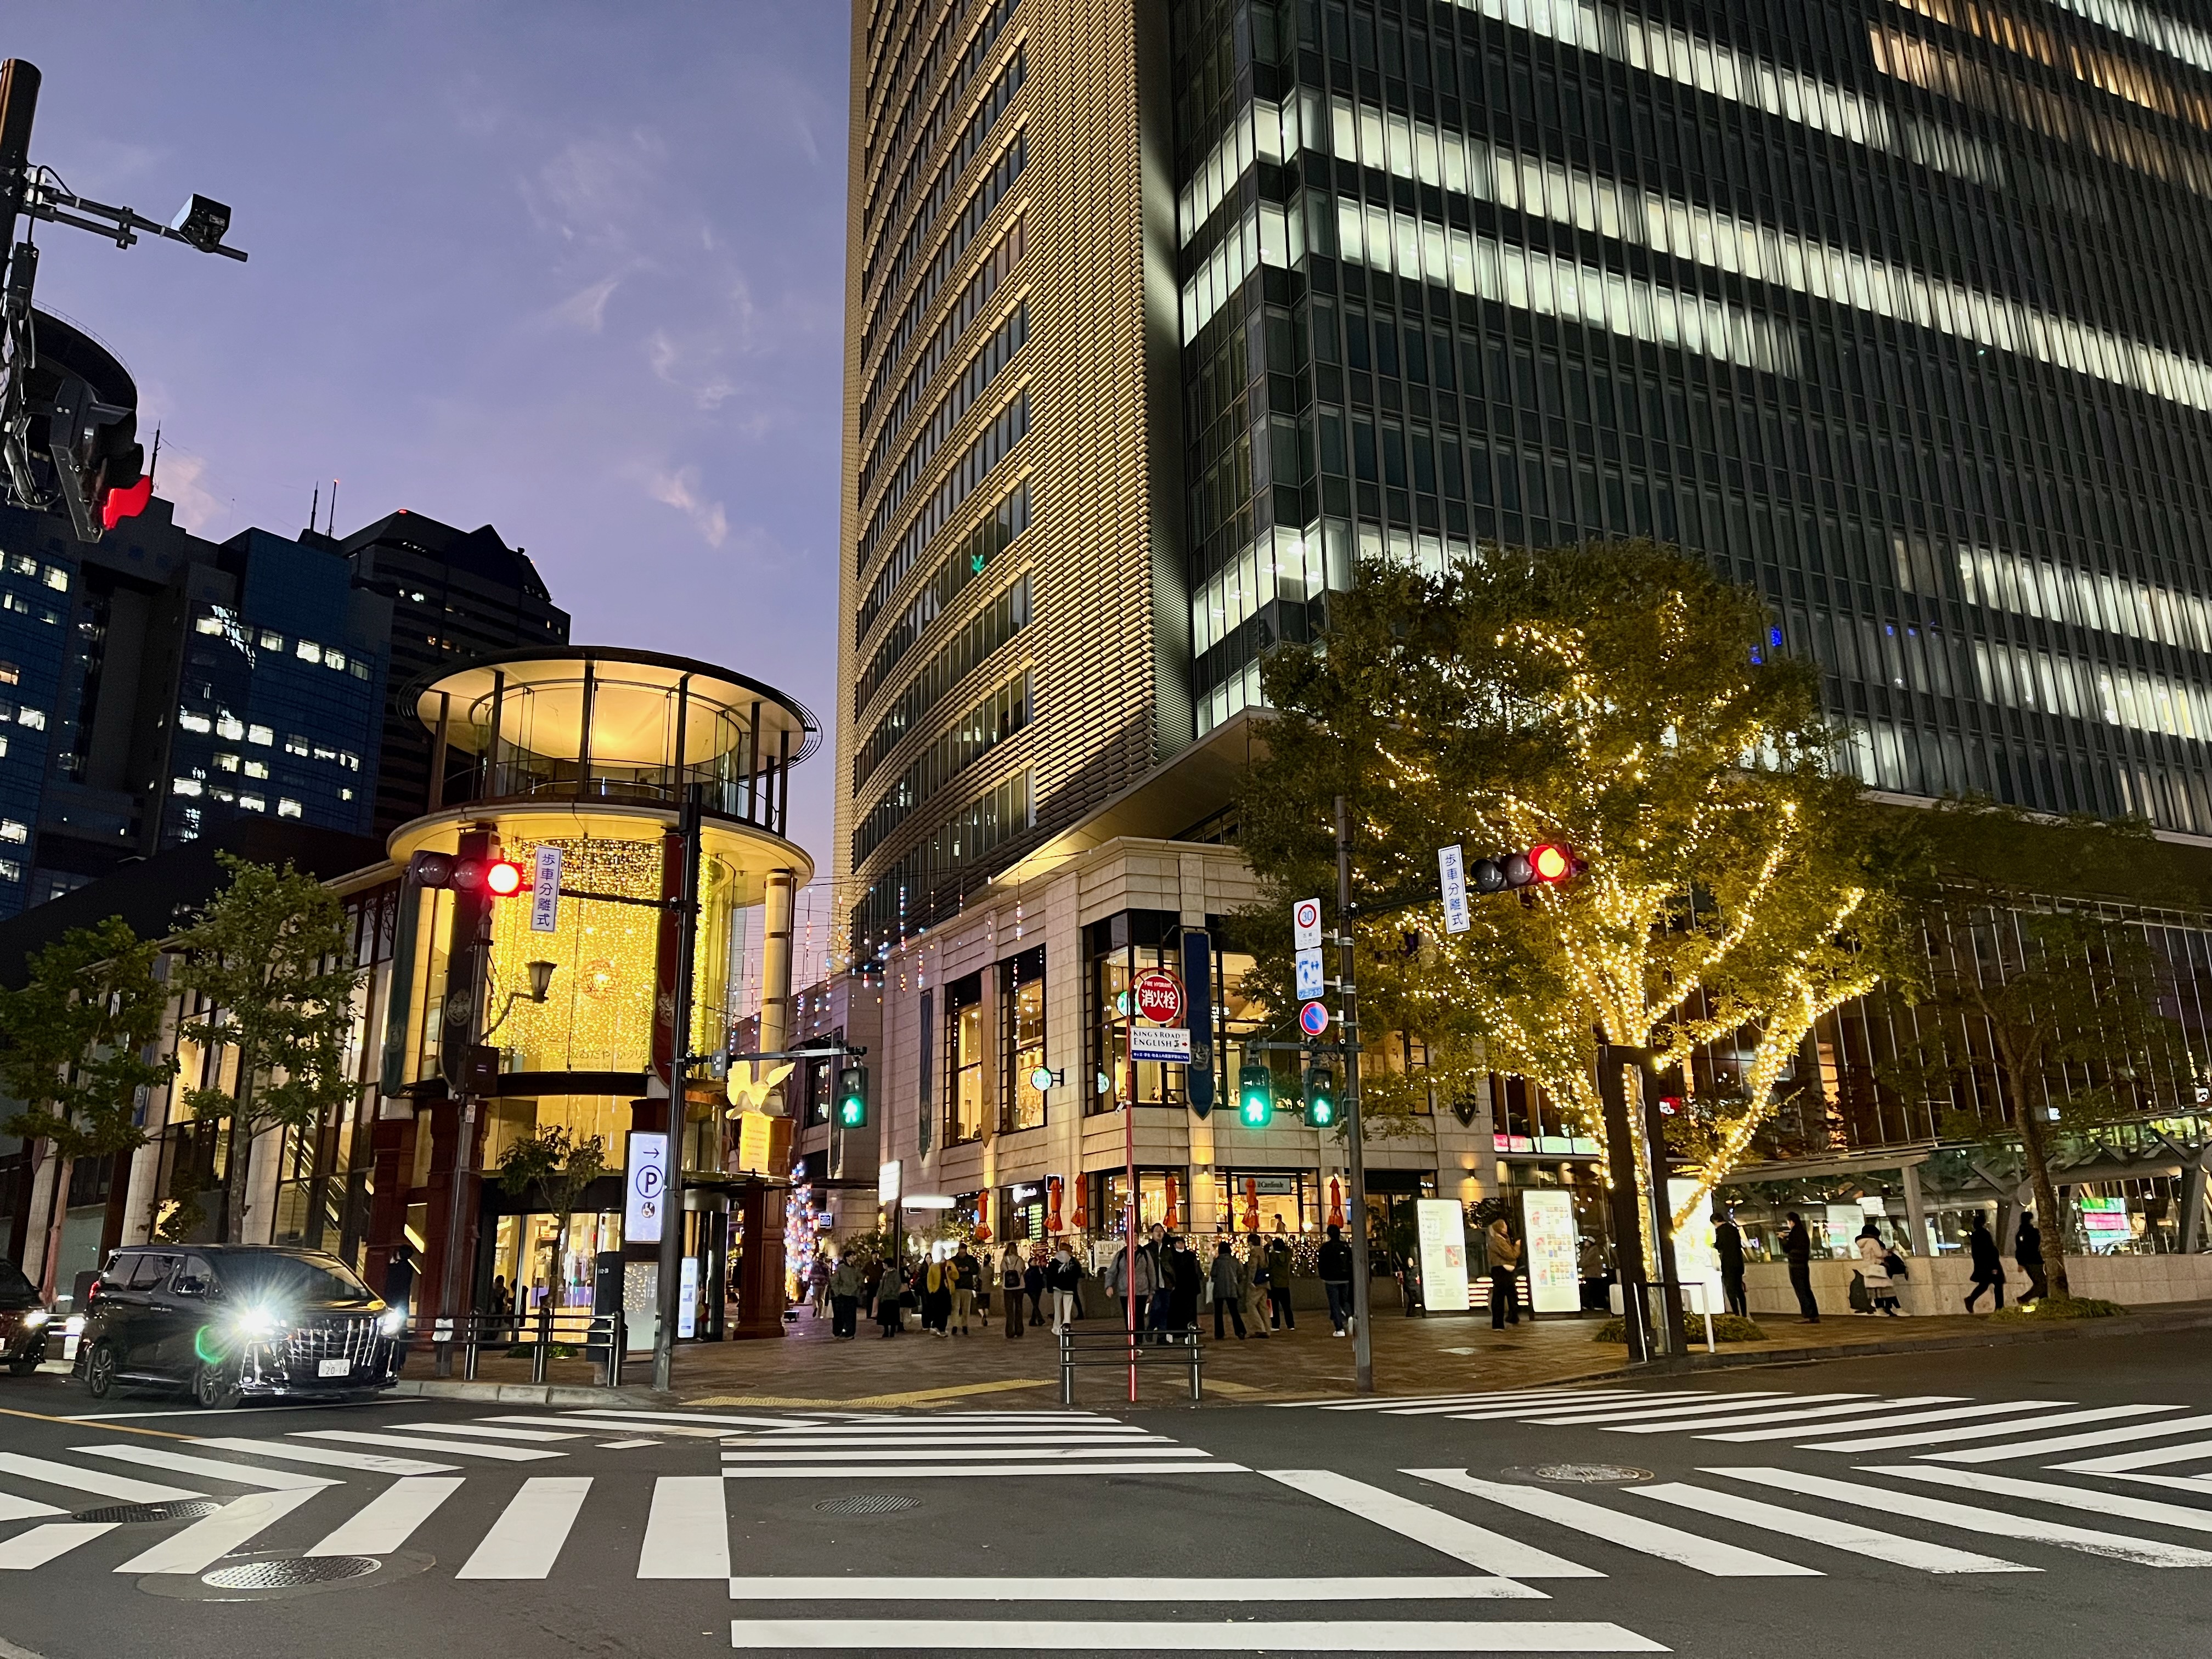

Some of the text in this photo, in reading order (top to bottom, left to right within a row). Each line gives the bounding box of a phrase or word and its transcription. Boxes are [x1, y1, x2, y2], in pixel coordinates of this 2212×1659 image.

[537, 853, 555, 927] 歩車分離式
[1445, 854, 1463, 926] 歩車分離式
[1302, 910, 1312, 922] 30
[1141, 989, 1176, 1009] 消火栓
[1133, 1037, 1172, 1047] ENGLISH
[645, 1172, 657, 1193] P
[326, 1366, 347, 1375] 20-16
